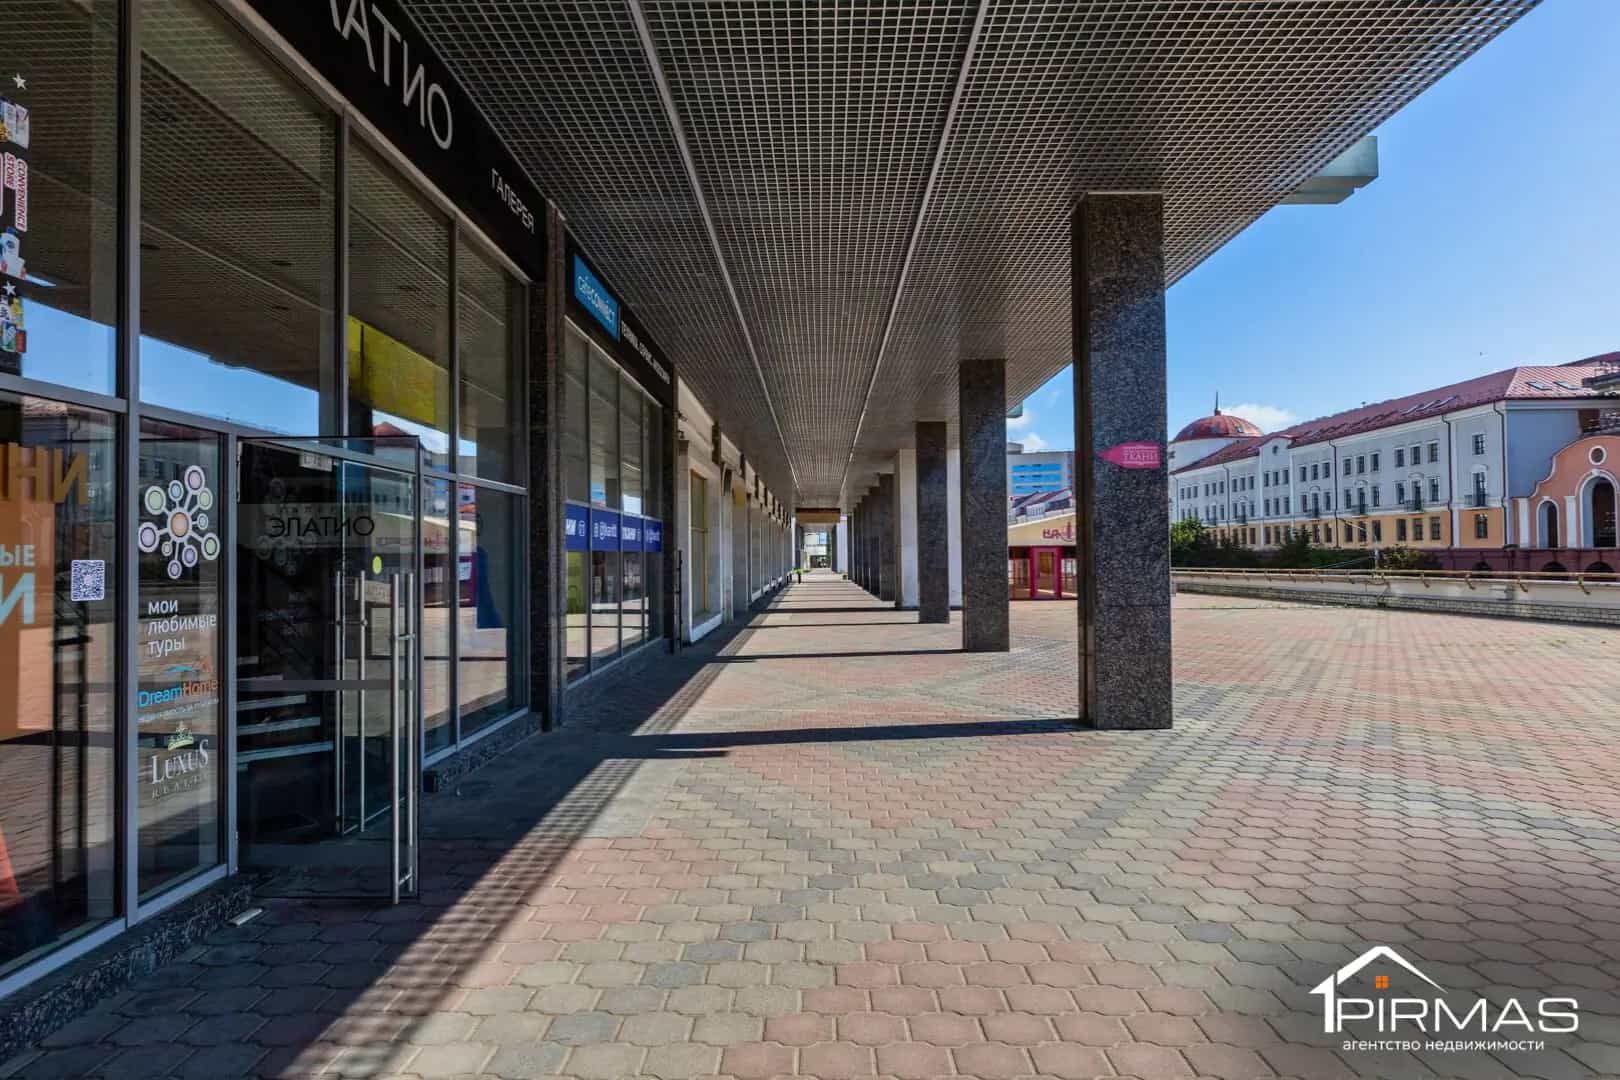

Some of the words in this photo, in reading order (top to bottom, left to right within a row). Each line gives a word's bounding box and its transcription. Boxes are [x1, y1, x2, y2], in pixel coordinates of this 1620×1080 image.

[6, 155, 15, 187] STORE
[17, 160, 26, 229] CONVENIENCE
[491, 168, 535, 234] ГАЛЕРЕЯ
[148, 600, 178, 615] мои
[148, 614, 217, 636] любимые
[148, 637, 185, 658] туры
